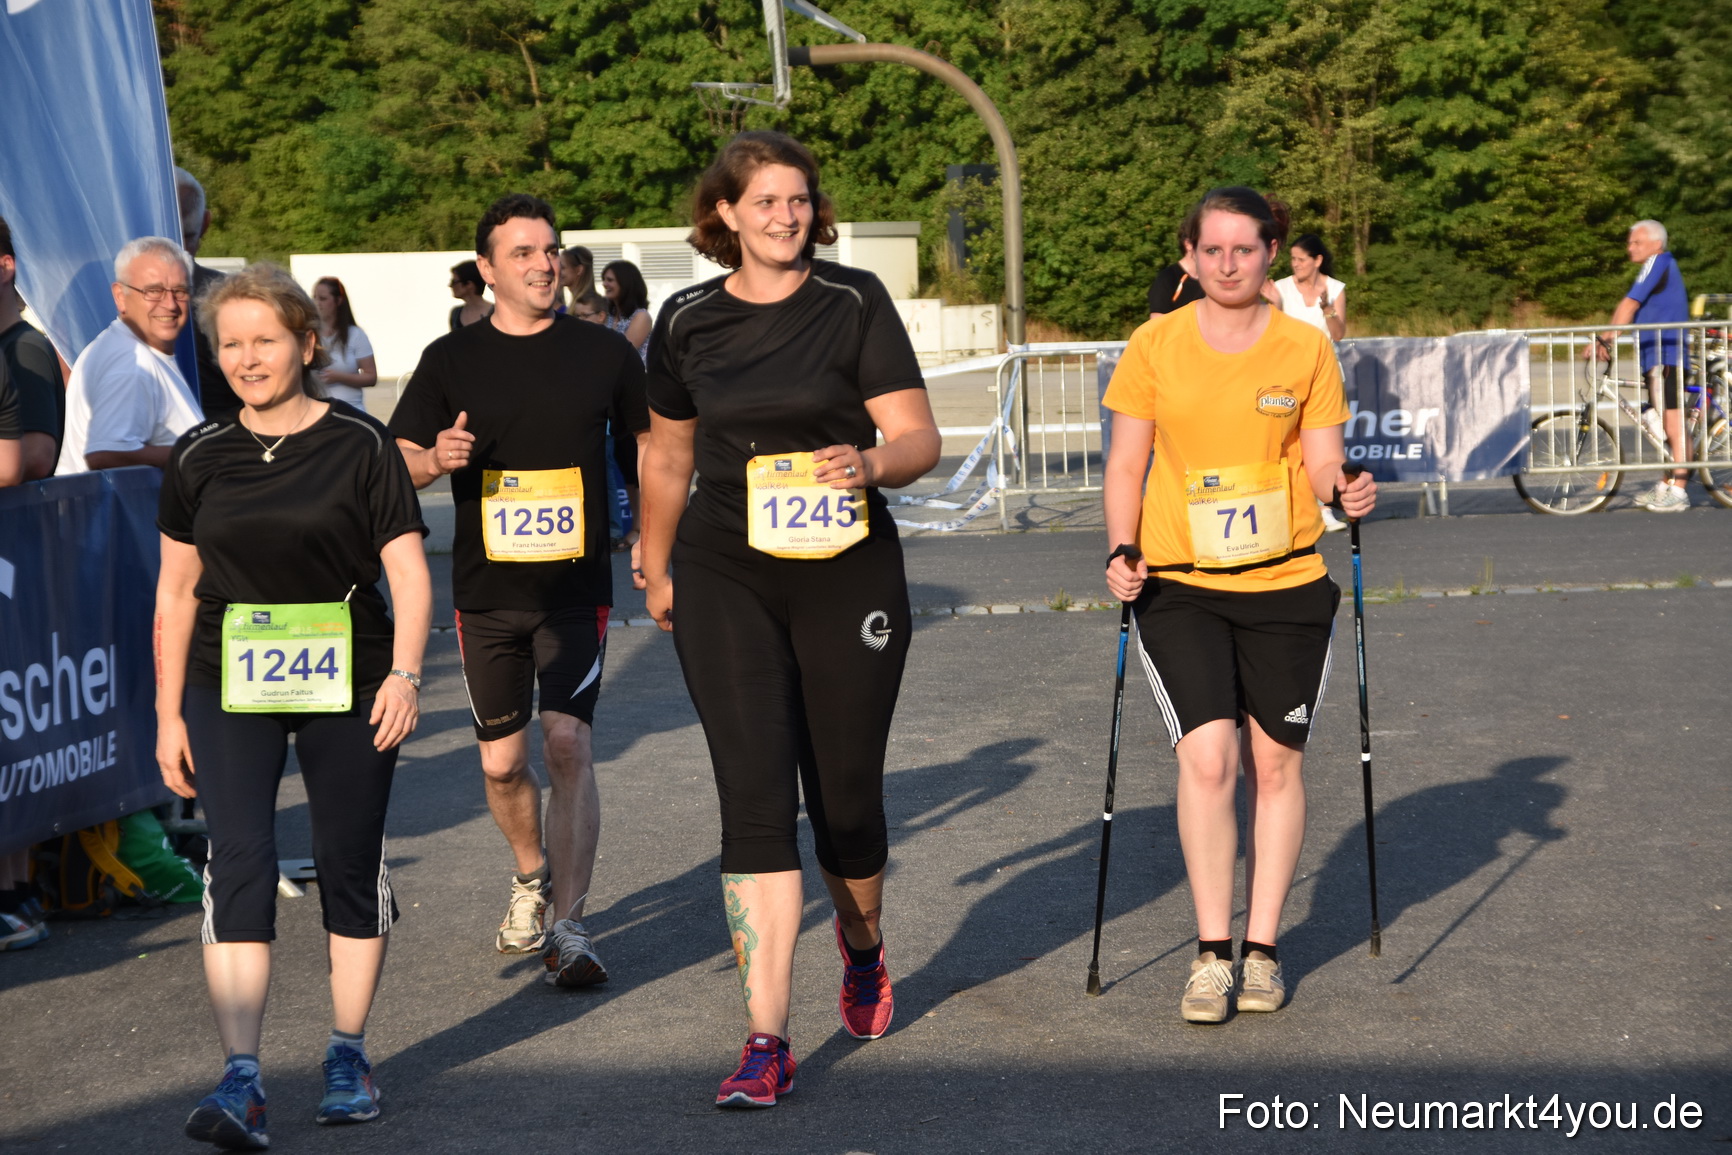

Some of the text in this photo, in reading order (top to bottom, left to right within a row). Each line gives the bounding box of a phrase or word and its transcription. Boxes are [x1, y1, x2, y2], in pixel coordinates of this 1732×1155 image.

[1344, 443, 1424, 460] OBILE
[493, 506, 575, 536] 1258
[763, 495, 857, 529] 1245
[1216, 504, 1258, 539] 71
[1240, 542, 1260, 550] Ulrich
[237, 646, 339, 682] 1244
[1284, 715, 1309, 724] adidas
